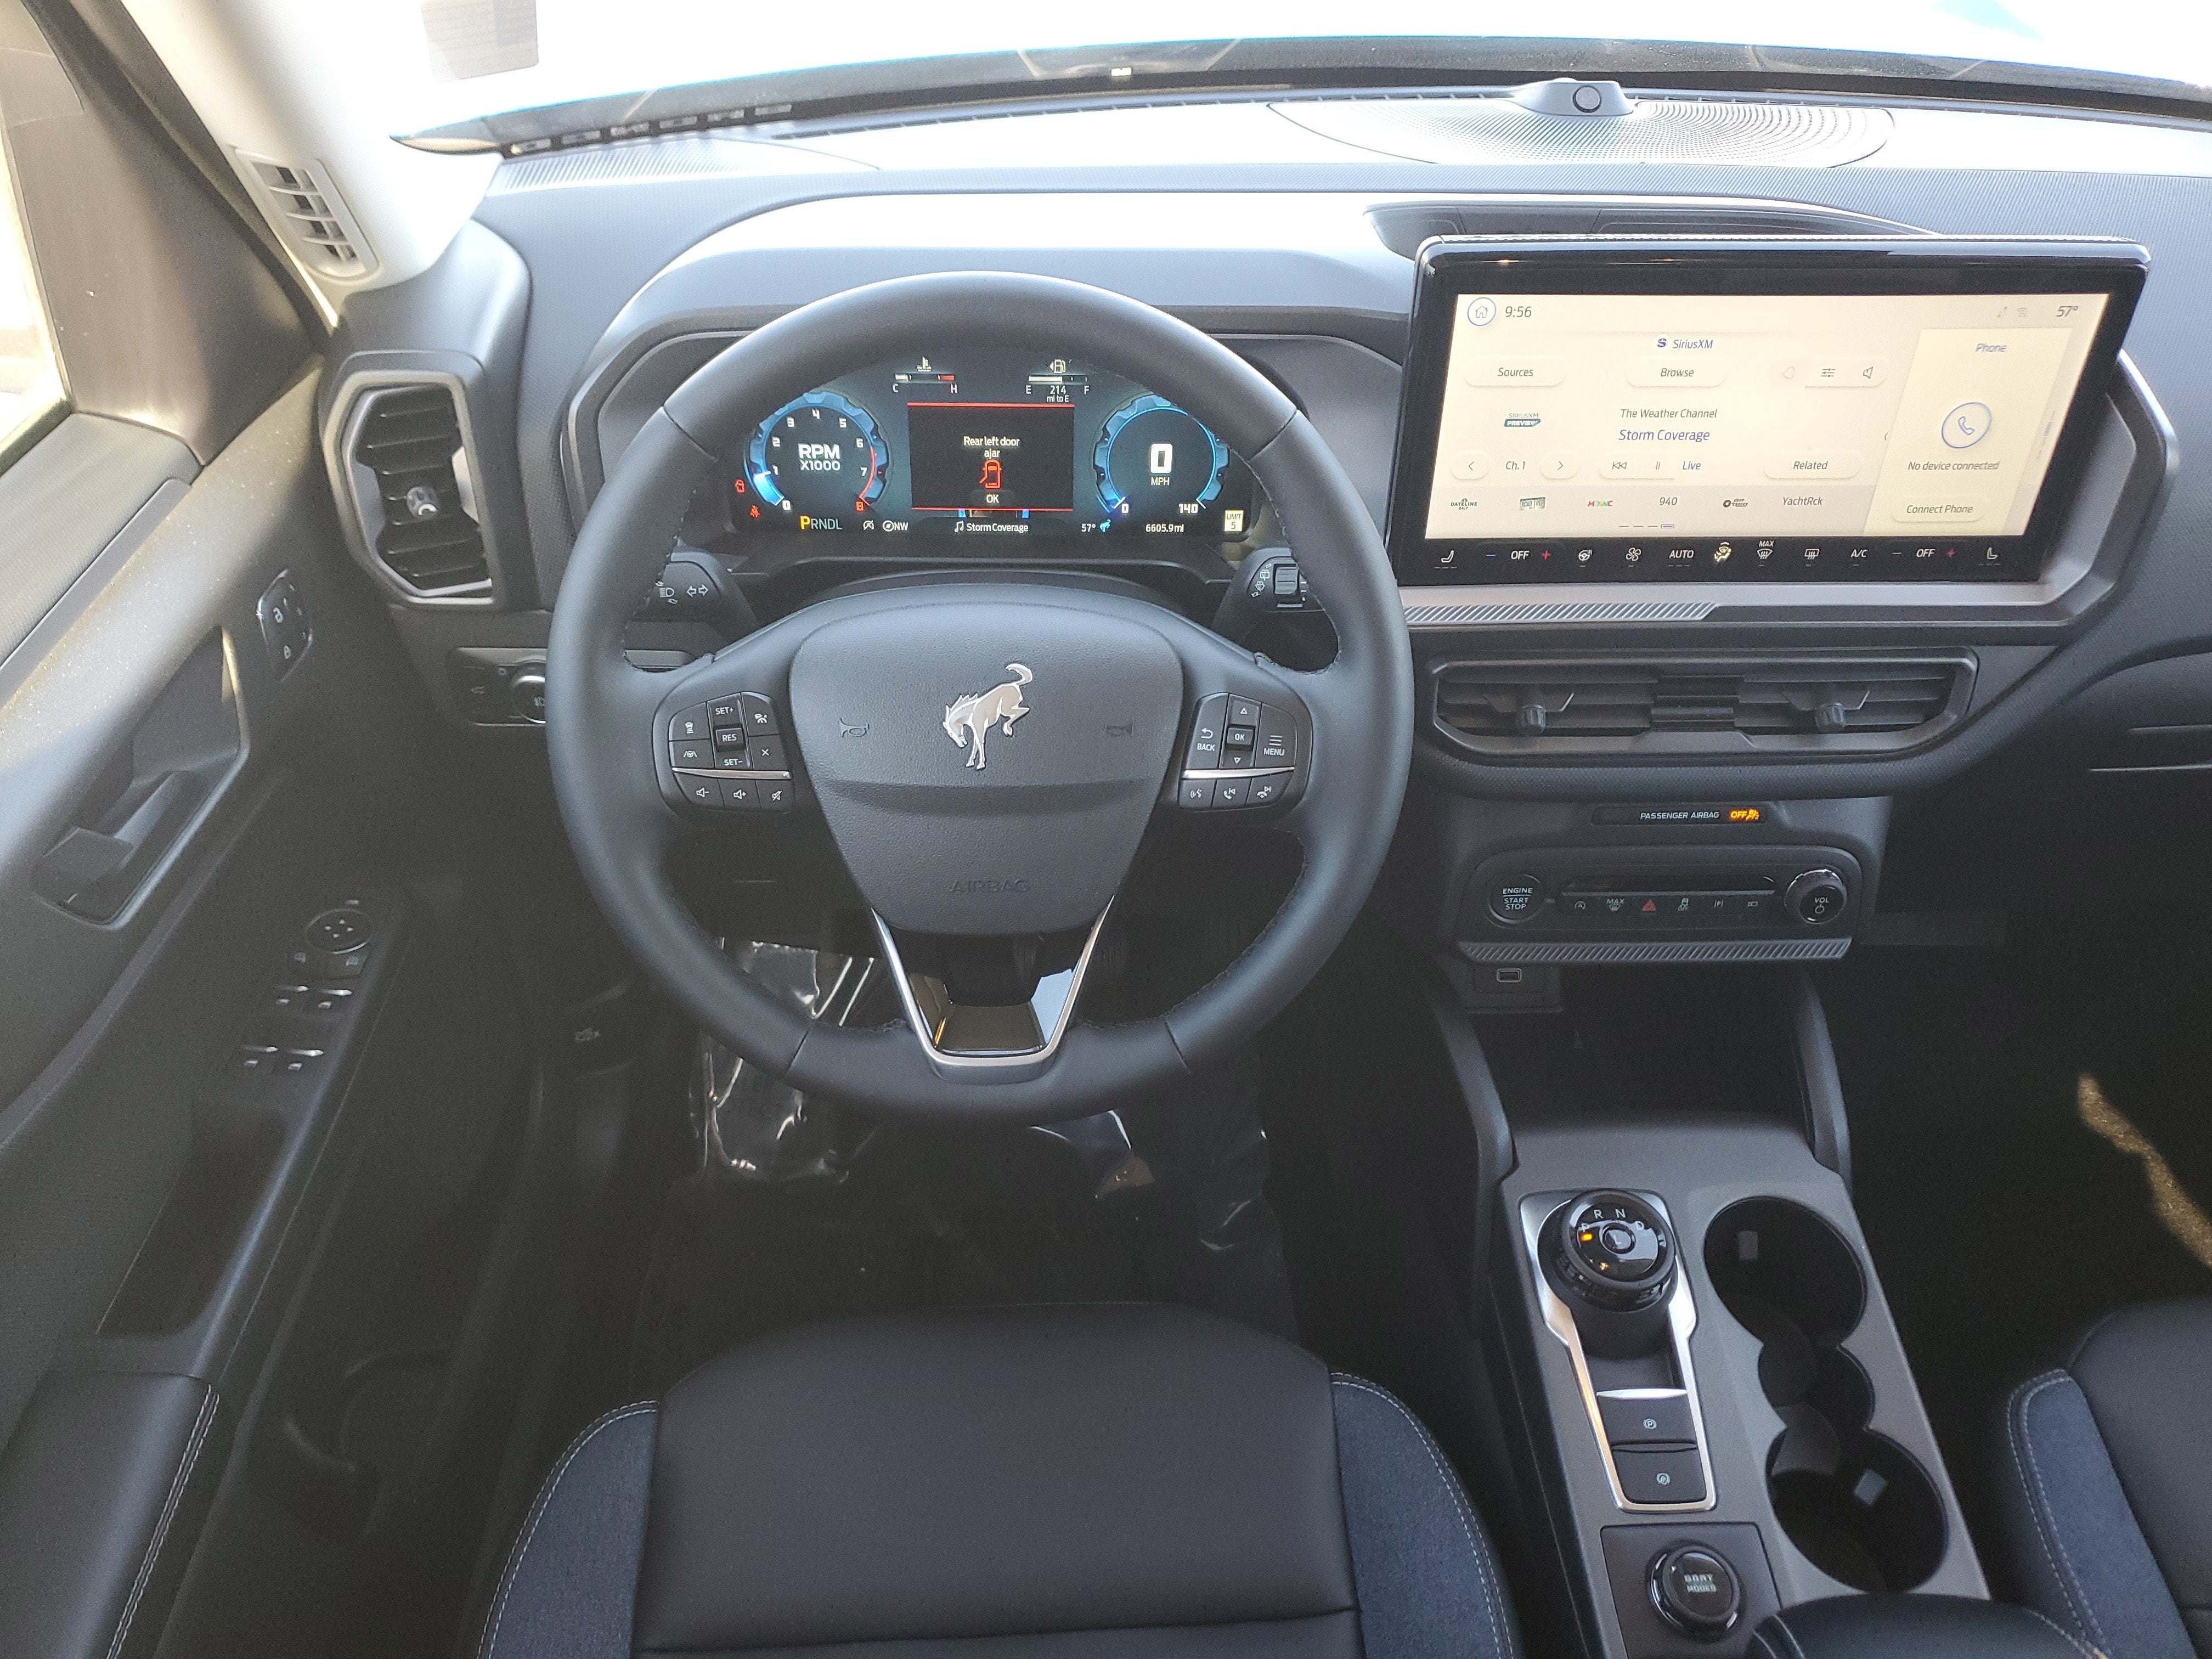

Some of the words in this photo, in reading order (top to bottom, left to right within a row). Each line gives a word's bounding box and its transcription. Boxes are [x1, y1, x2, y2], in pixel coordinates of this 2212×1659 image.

[1505, 306, 1532, 318] 9:56
[2056, 306, 2079, 318] 57°
[1672, 339, 1713, 349] SiriusXM
[1976, 342, 2007, 353] Phone
[1497, 367, 1534, 377] Sources
[1660, 368, 1695, 377] Browse
[892, 383, 899, 393] C
[950, 383, 958, 394] H
[1025, 386, 1032, 394] E
[1049, 386, 1066, 394] 214
[1084, 386, 1090, 395] F
[812, 408, 821, 419] 4
[1620, 409, 1638, 418] The
[1640, 408, 1679, 418] Weather
[1680, 408, 1718, 418] Channel
[786, 417, 795, 428] 3
[839, 417, 847, 428] 5
[1618, 429, 1655, 441] Storm
[1657, 429, 1710, 443] Coverage
[771, 437, 781, 448] 2
[856, 437, 864, 448] 6
[963, 436, 983, 447] Rear
[984, 437, 999, 447] left
[1000, 437, 1020, 447] door
[798, 444, 841, 460] RPM
[984, 448, 1001, 459] ajar
[1150, 443, 1173, 474] 0
[772, 465, 779, 476] 1
[799, 460, 841, 472] X1000
[1505, 461, 1520, 470] Ch.
[1522, 461, 1526, 470] 1
[1682, 461, 1701, 470] Live
[1793, 461, 1829, 470] Related
[1908, 461, 1921, 471] No
[1922, 461, 1951, 471] device
[1952, 461, 2000, 471] connected
[860, 466, 867, 477] 7
[1150, 477, 1170, 486] MPH
[986, 494, 1000, 504] OK
[1659, 496, 1678, 506] 940
[1782, 496, 1822, 506] YachtRck
[782, 499, 791, 511] 0
[1121, 504, 1129, 514] 0
[1178, 504, 1199, 514] 140
[1906, 505, 1943, 514] Connect
[1944, 504, 1973, 514] Phone
[894, 522, 909, 532] NW
[966, 522, 991, 532] Storm
[992, 523, 1029, 533] Coverage
[1081, 523, 1096, 533] 57°
[1231, 521, 1237, 530] 5
[1510, 550, 1530, 560] OFF
[1668, 550, 1694, 559] AUTO
[1850, 549, 1869, 558] A/C
[1916, 549, 1936, 558] OFF
[715, 707, 734, 715] SET+
[721, 733, 737, 743] RES
[1197, 743, 1215, 752] BACK
[1263, 747, 1285, 757] MENU
[1640, 811, 1689, 820] PASSENGER
[1690, 811, 1720, 820] AIRBAG
[1730, 810, 1747, 820] OFF
[949, 878, 1029, 893] AIRBAG
[1505, 902, 1527, 911] STOP
[1593, 1209, 1604, 1220] R
[1615, 1208, 1627, 1219] N
[1634, 1221, 1645, 1230] D
